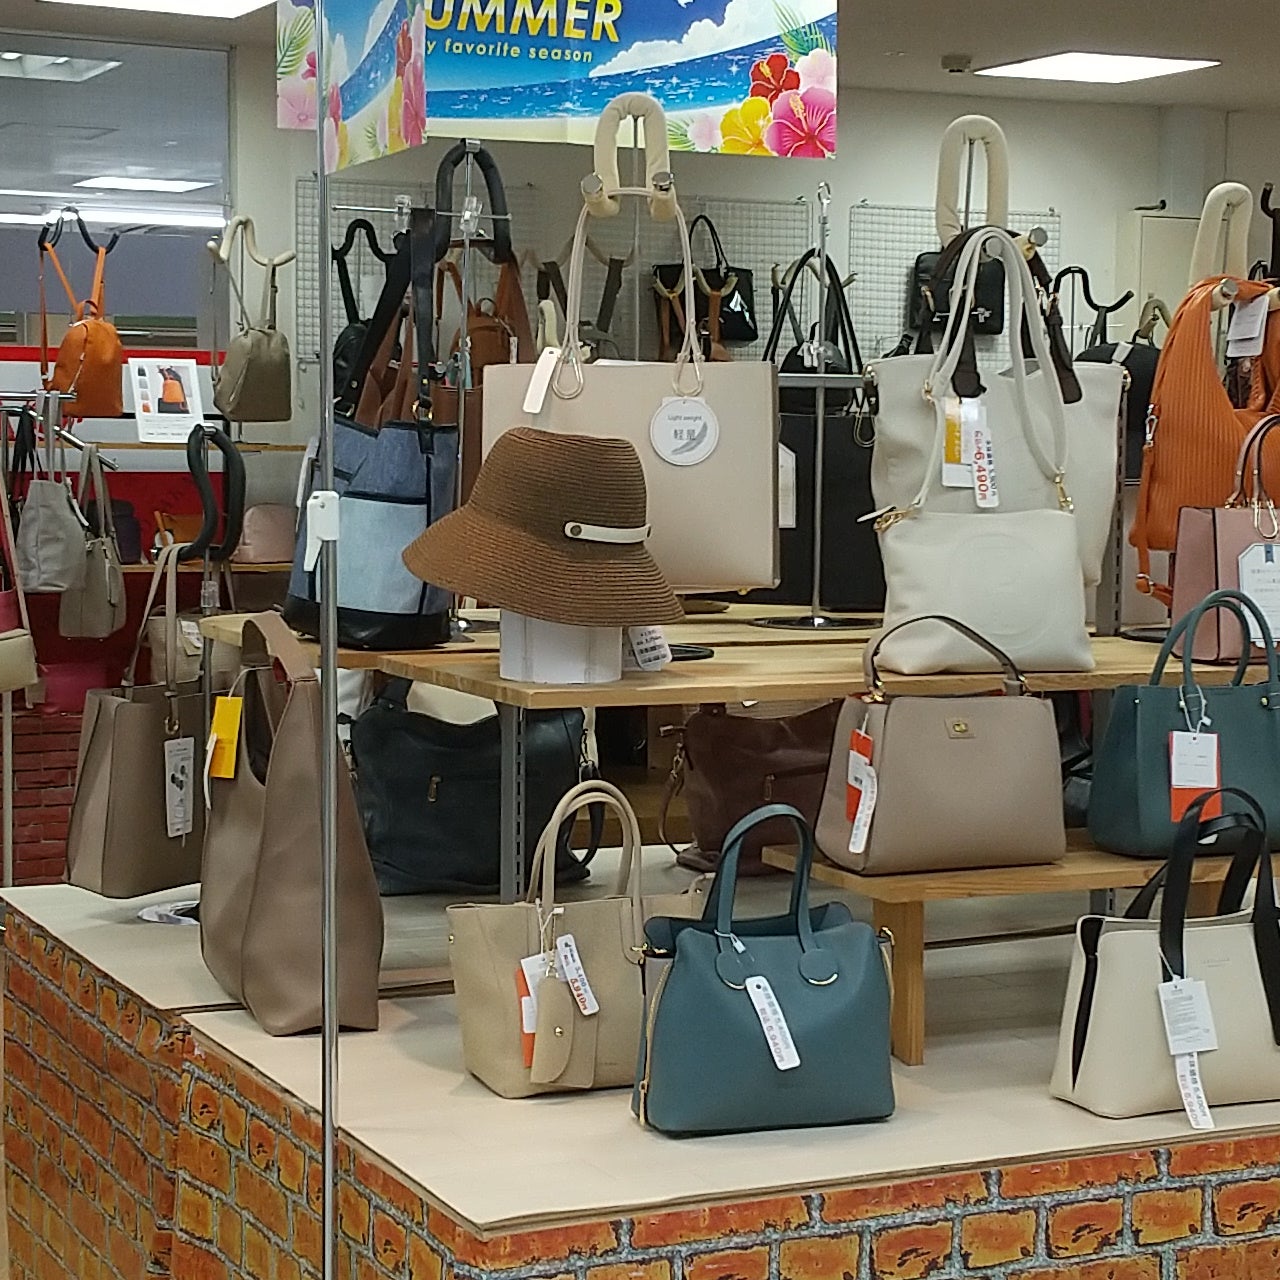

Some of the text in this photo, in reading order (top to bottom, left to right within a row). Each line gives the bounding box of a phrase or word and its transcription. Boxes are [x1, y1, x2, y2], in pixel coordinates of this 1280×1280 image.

[425, 0, 623, 43] UMMER
[445, 38, 521, 58] favorite
[528, 45, 593, 63] season
